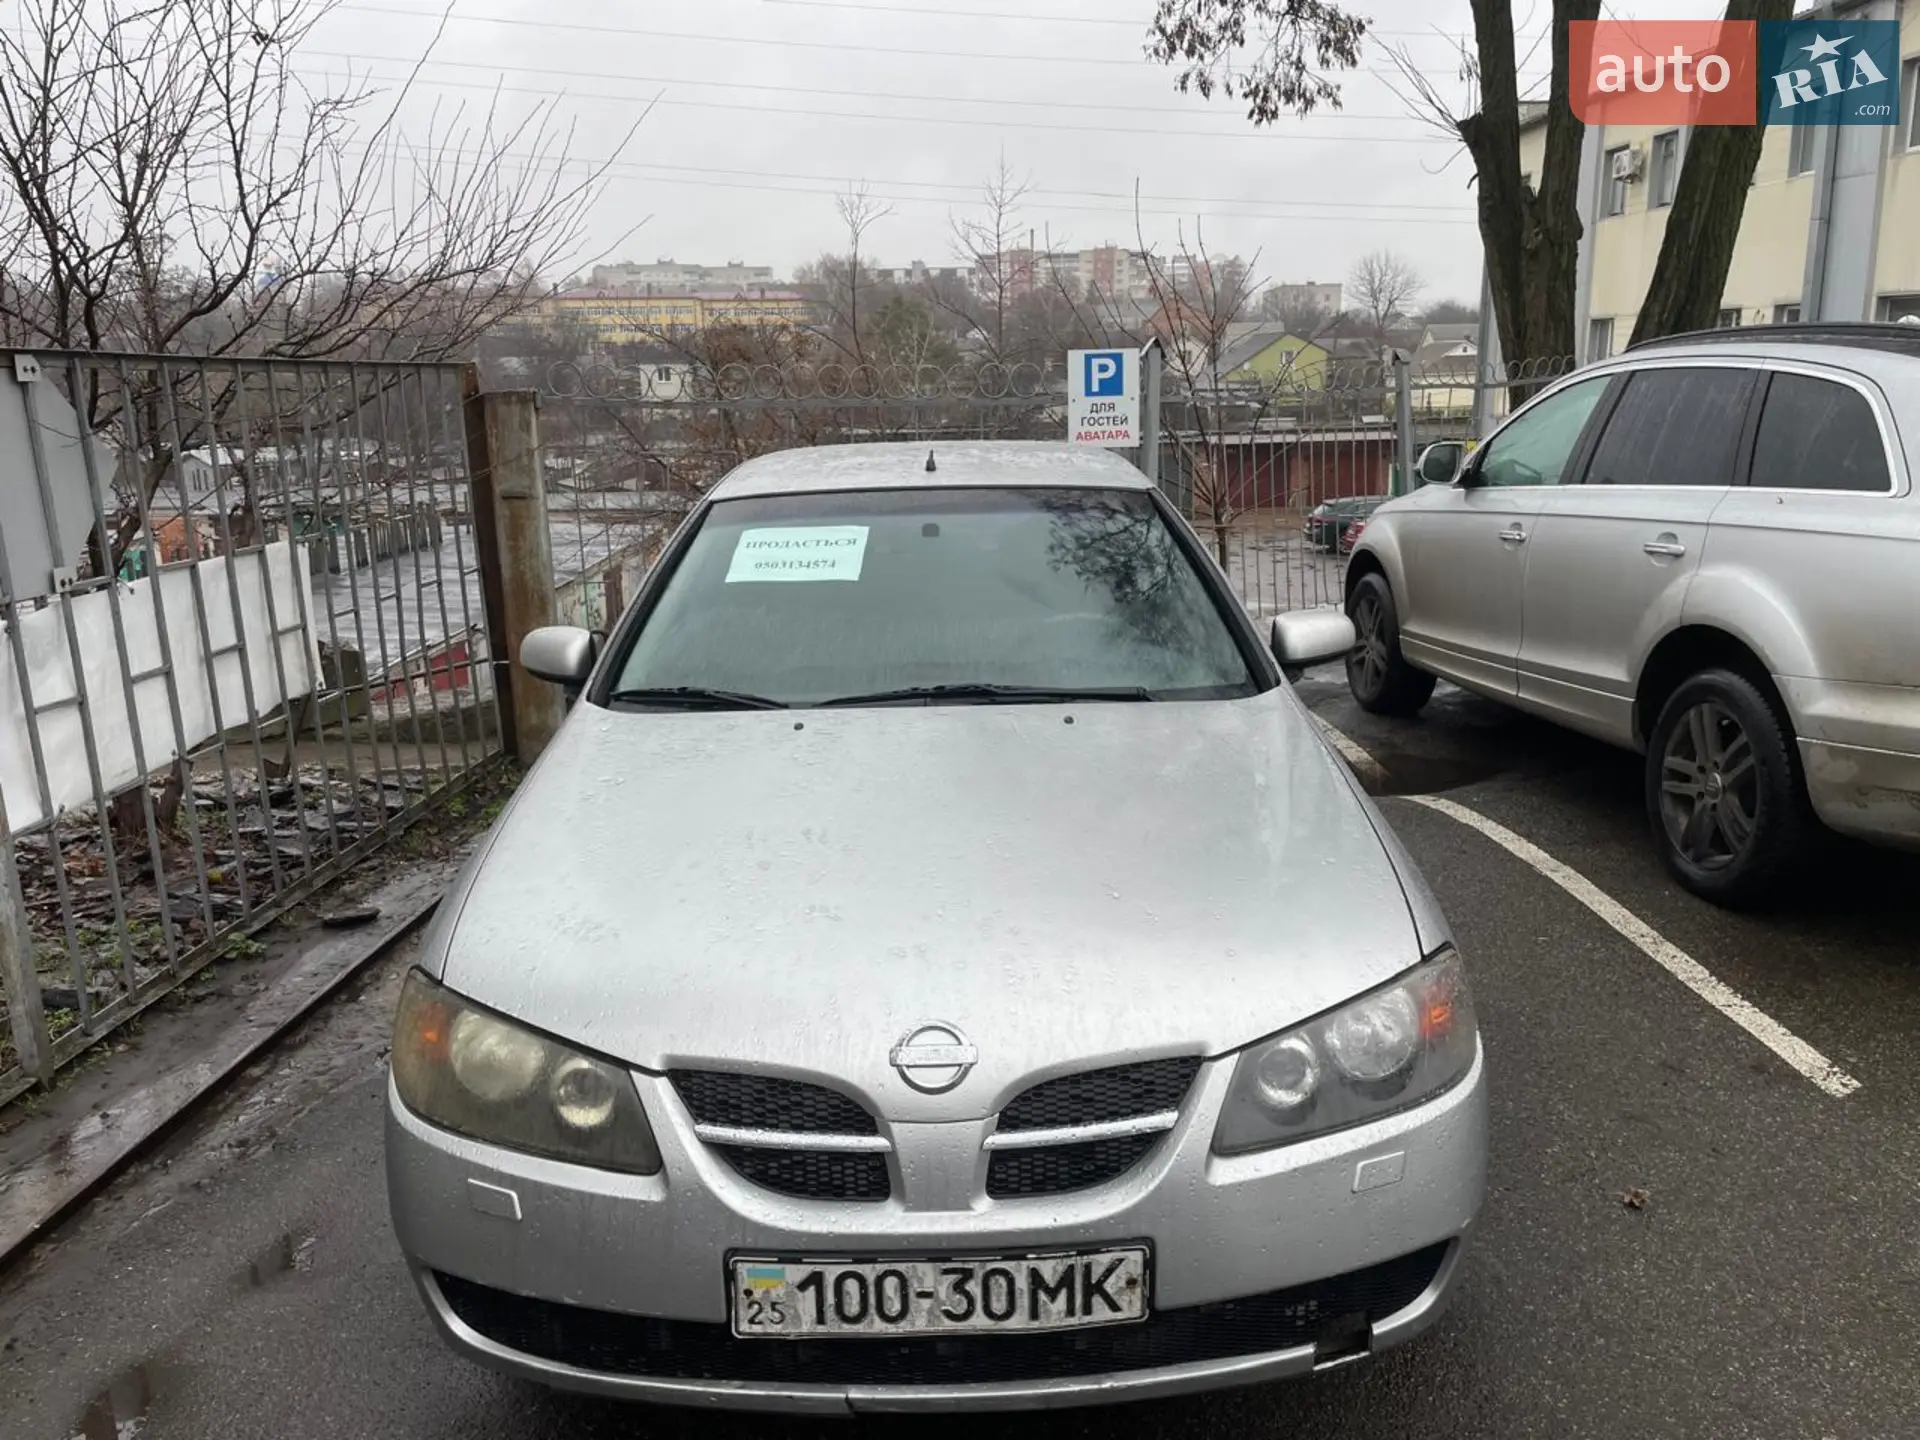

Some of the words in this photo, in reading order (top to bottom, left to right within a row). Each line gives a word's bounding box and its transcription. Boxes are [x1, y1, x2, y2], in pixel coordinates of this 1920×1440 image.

[1091, 358, 1116, 392] P
[1090, 403, 1115, 414] ДЛЯ
[1081, 414, 1128, 426] ГОСТЕЙ
[1076, 430, 1130, 441] АВАТАРА
[746, 1301, 786, 1326] 25
